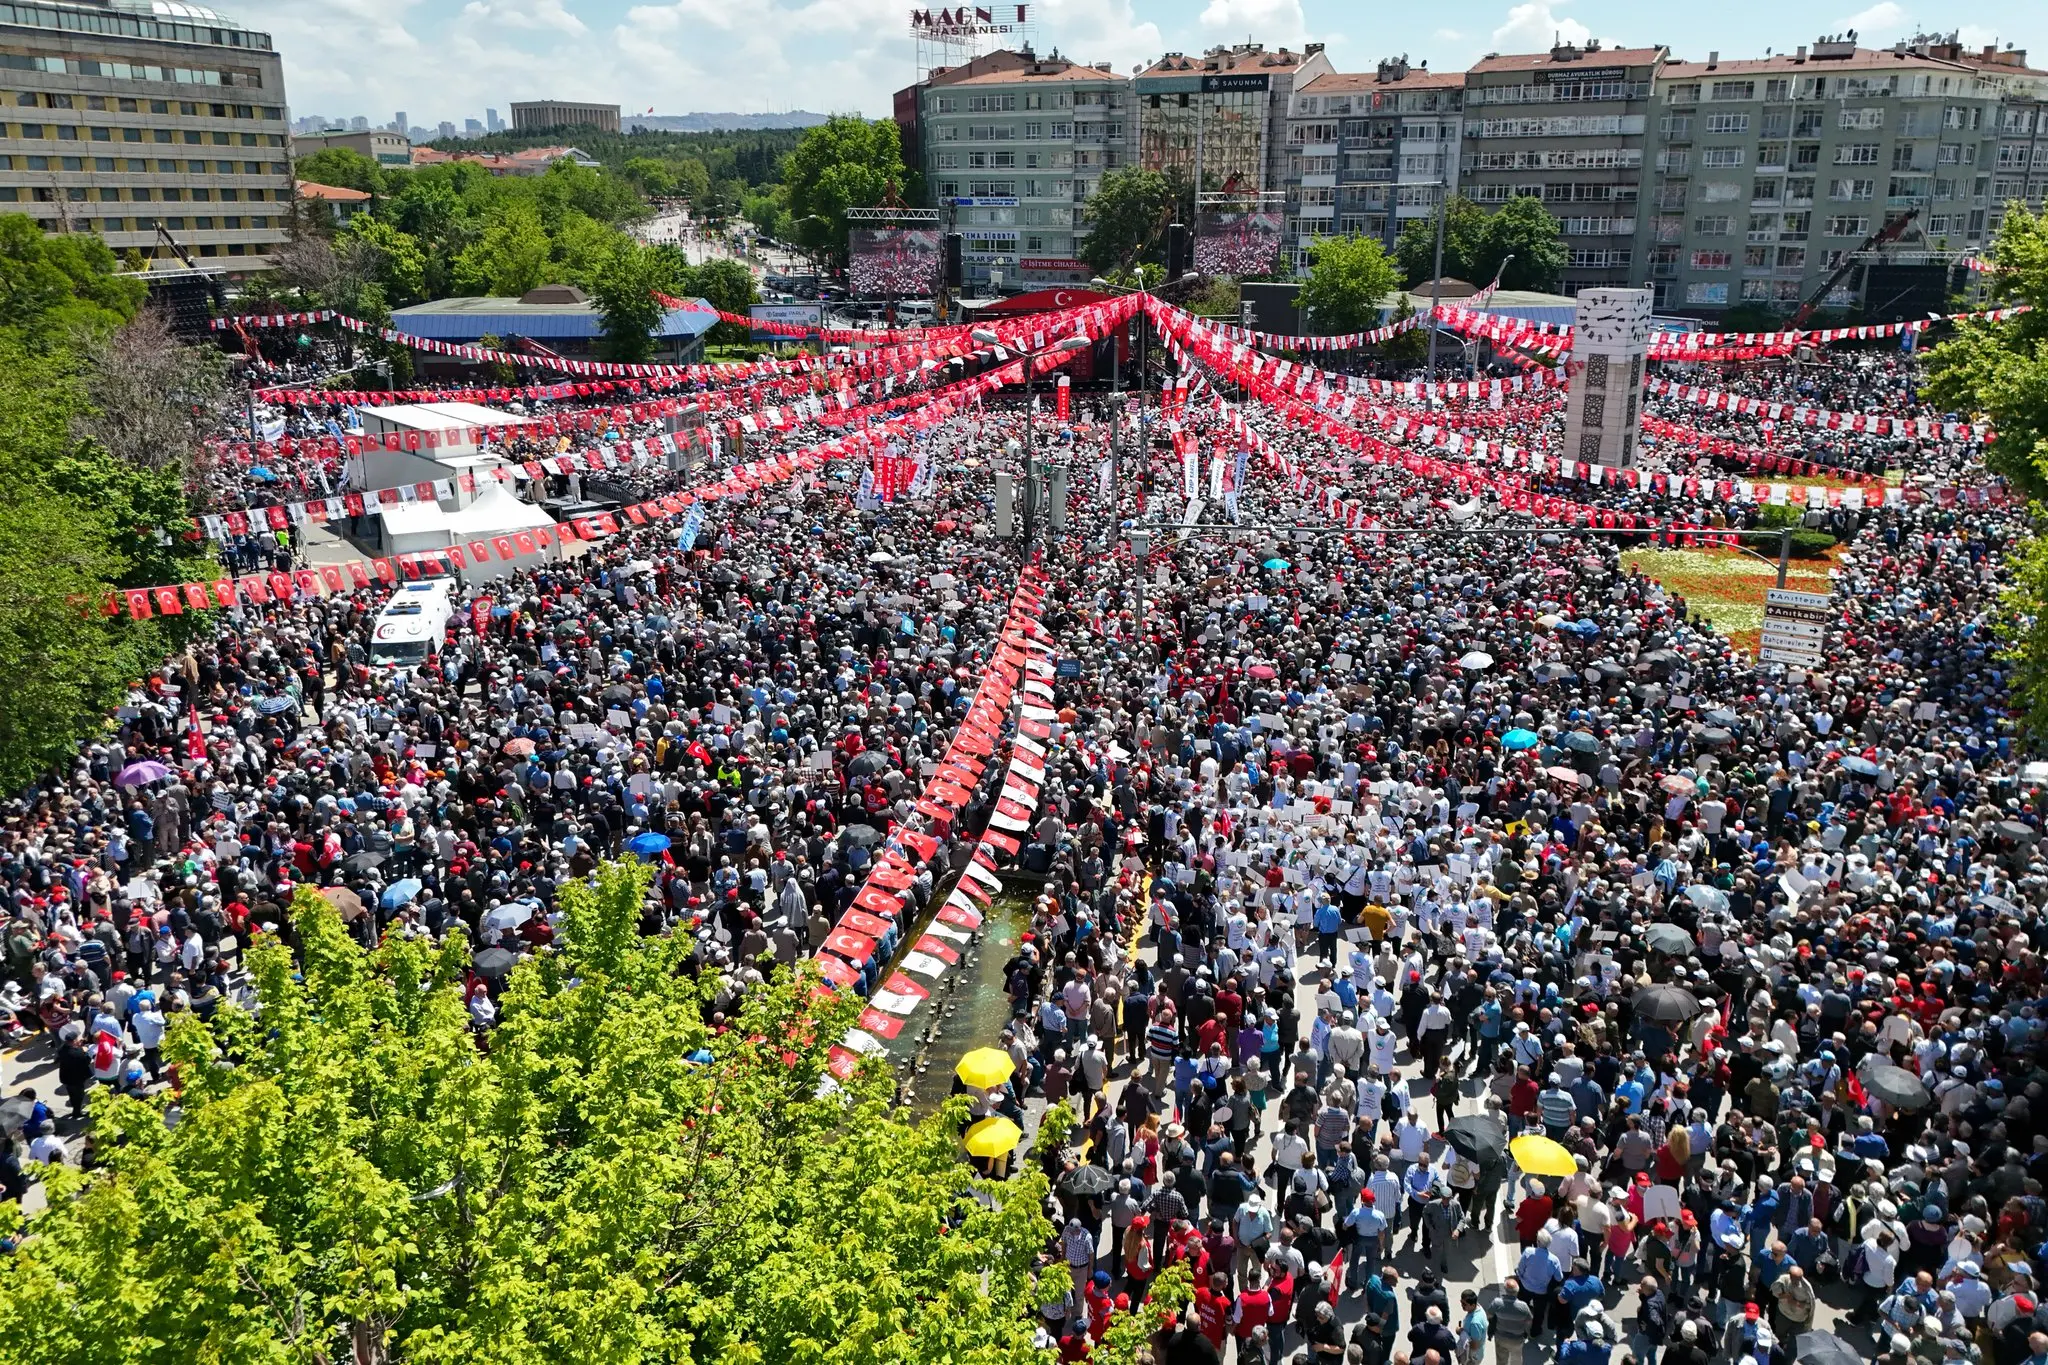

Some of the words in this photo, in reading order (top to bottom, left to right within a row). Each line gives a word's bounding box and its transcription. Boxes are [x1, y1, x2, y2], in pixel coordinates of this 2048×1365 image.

[1222, 79, 1263, 87] SAVUNMA
[1777, 594, 1822, 604] Anıttepe
[1775, 608, 1824, 620] Anıtkabir
[382, 627, 396, 635] 112
[1766, 622, 1798, 631] Emek
